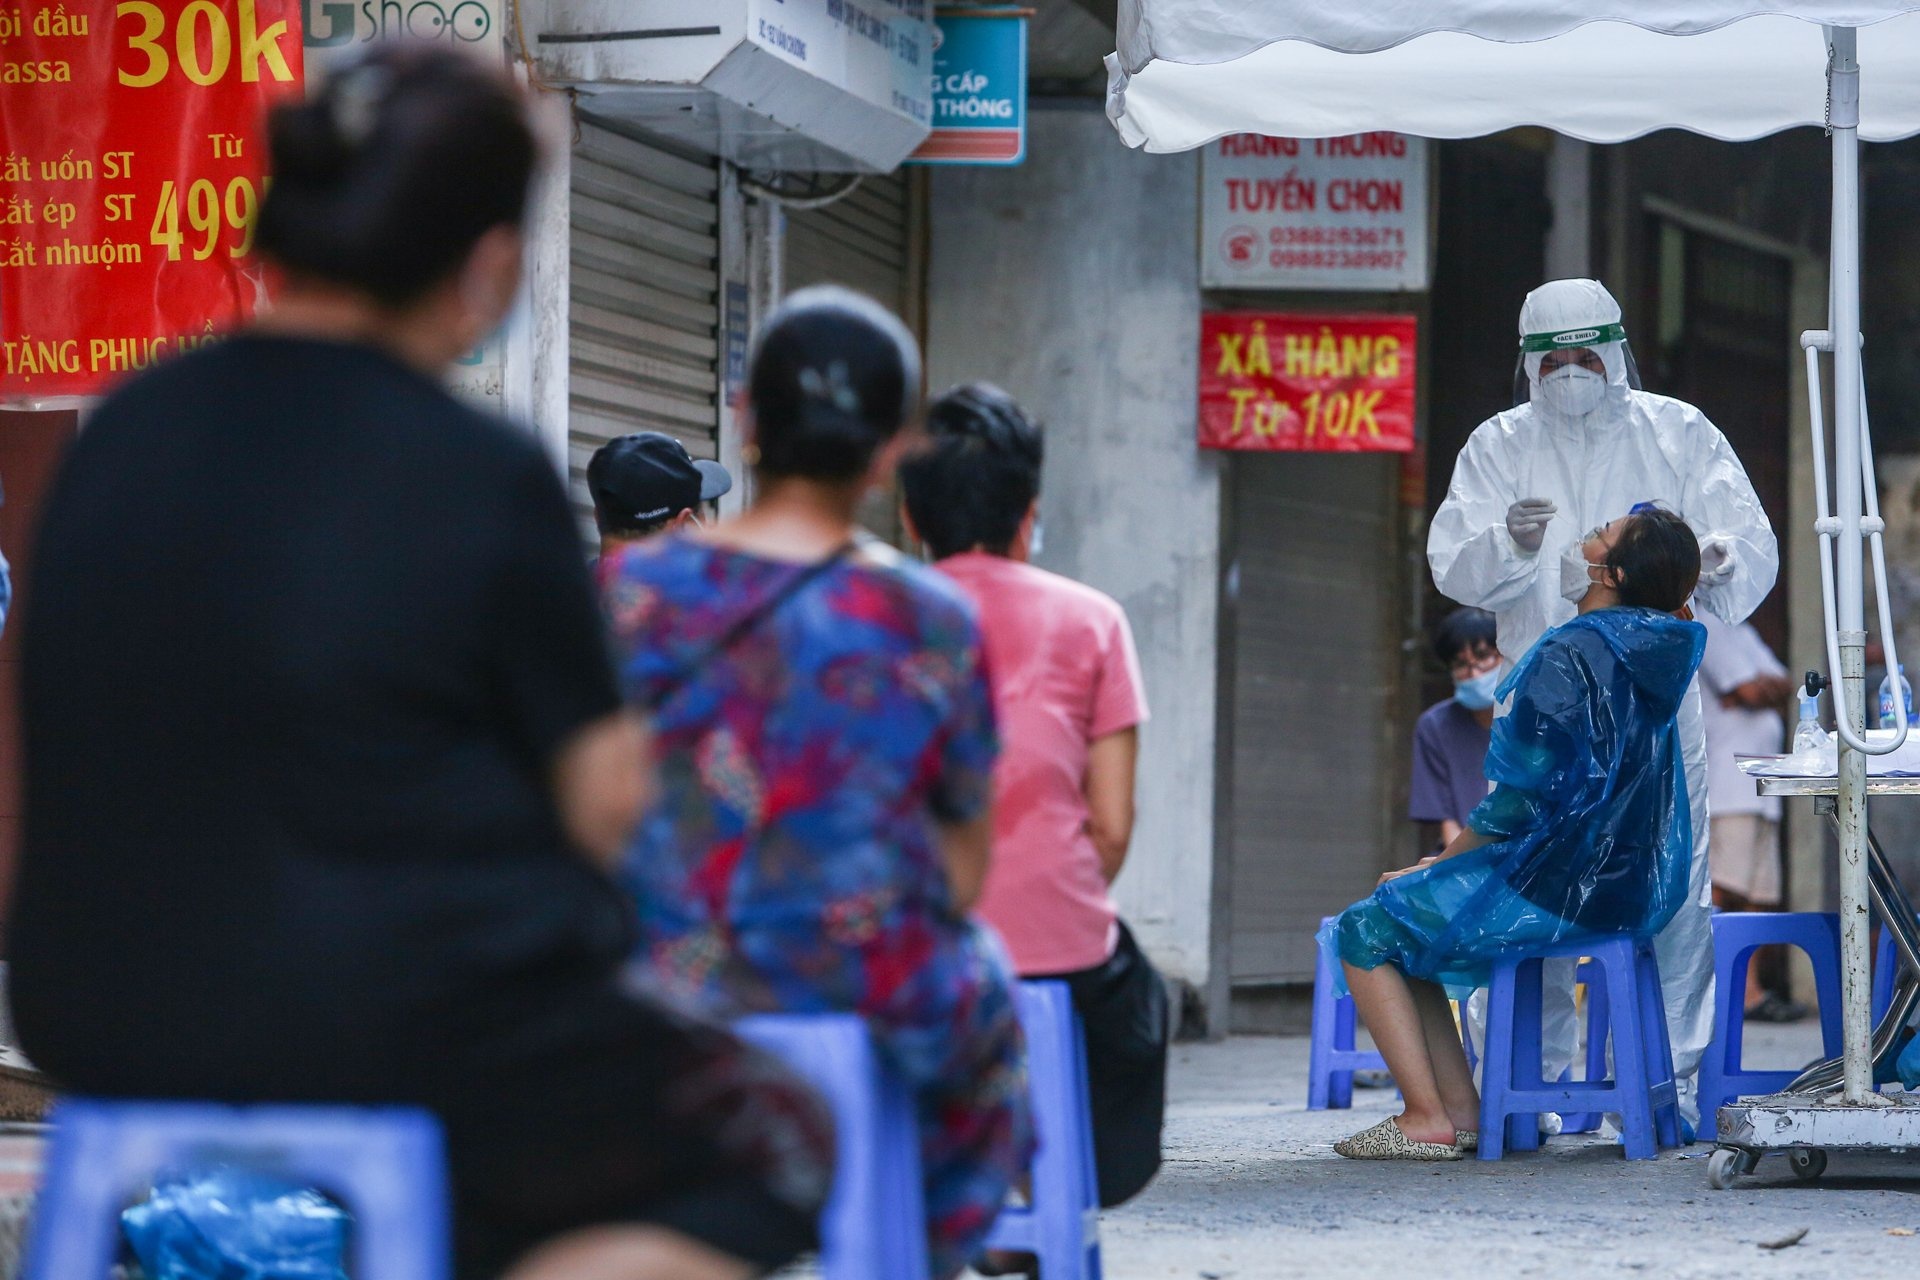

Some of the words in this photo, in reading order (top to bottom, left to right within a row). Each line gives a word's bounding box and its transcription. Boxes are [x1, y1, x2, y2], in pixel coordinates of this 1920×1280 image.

[0, 8, 21, 45] ội
[33, 3, 89, 37] đầu
[116, 0, 295, 88] 30k
[0, 60, 72, 84] assa
[945, 68, 990, 94] CẤP
[937, 94, 1014, 118] THÔNG
[207, 132, 244, 159] Từ
[0, 150, 33, 182] ắt
[40, 148, 94, 181] uốn
[102, 151, 136, 180] ST
[42, 196, 77, 230] ép
[103, 193, 137, 222] ST
[1326, 177, 1404, 222] CHỌN
[149, 175, 274, 262] 499
[45, 237, 142, 271] nhuộm
[1284, 324, 1400, 379] HÀNG
[1557, 334, 1573, 342] FACE
[1575, 331, 1597, 340] SHIELD
[3, 334, 81, 383] TẶNG
[1302, 389, 1385, 438] 10K
